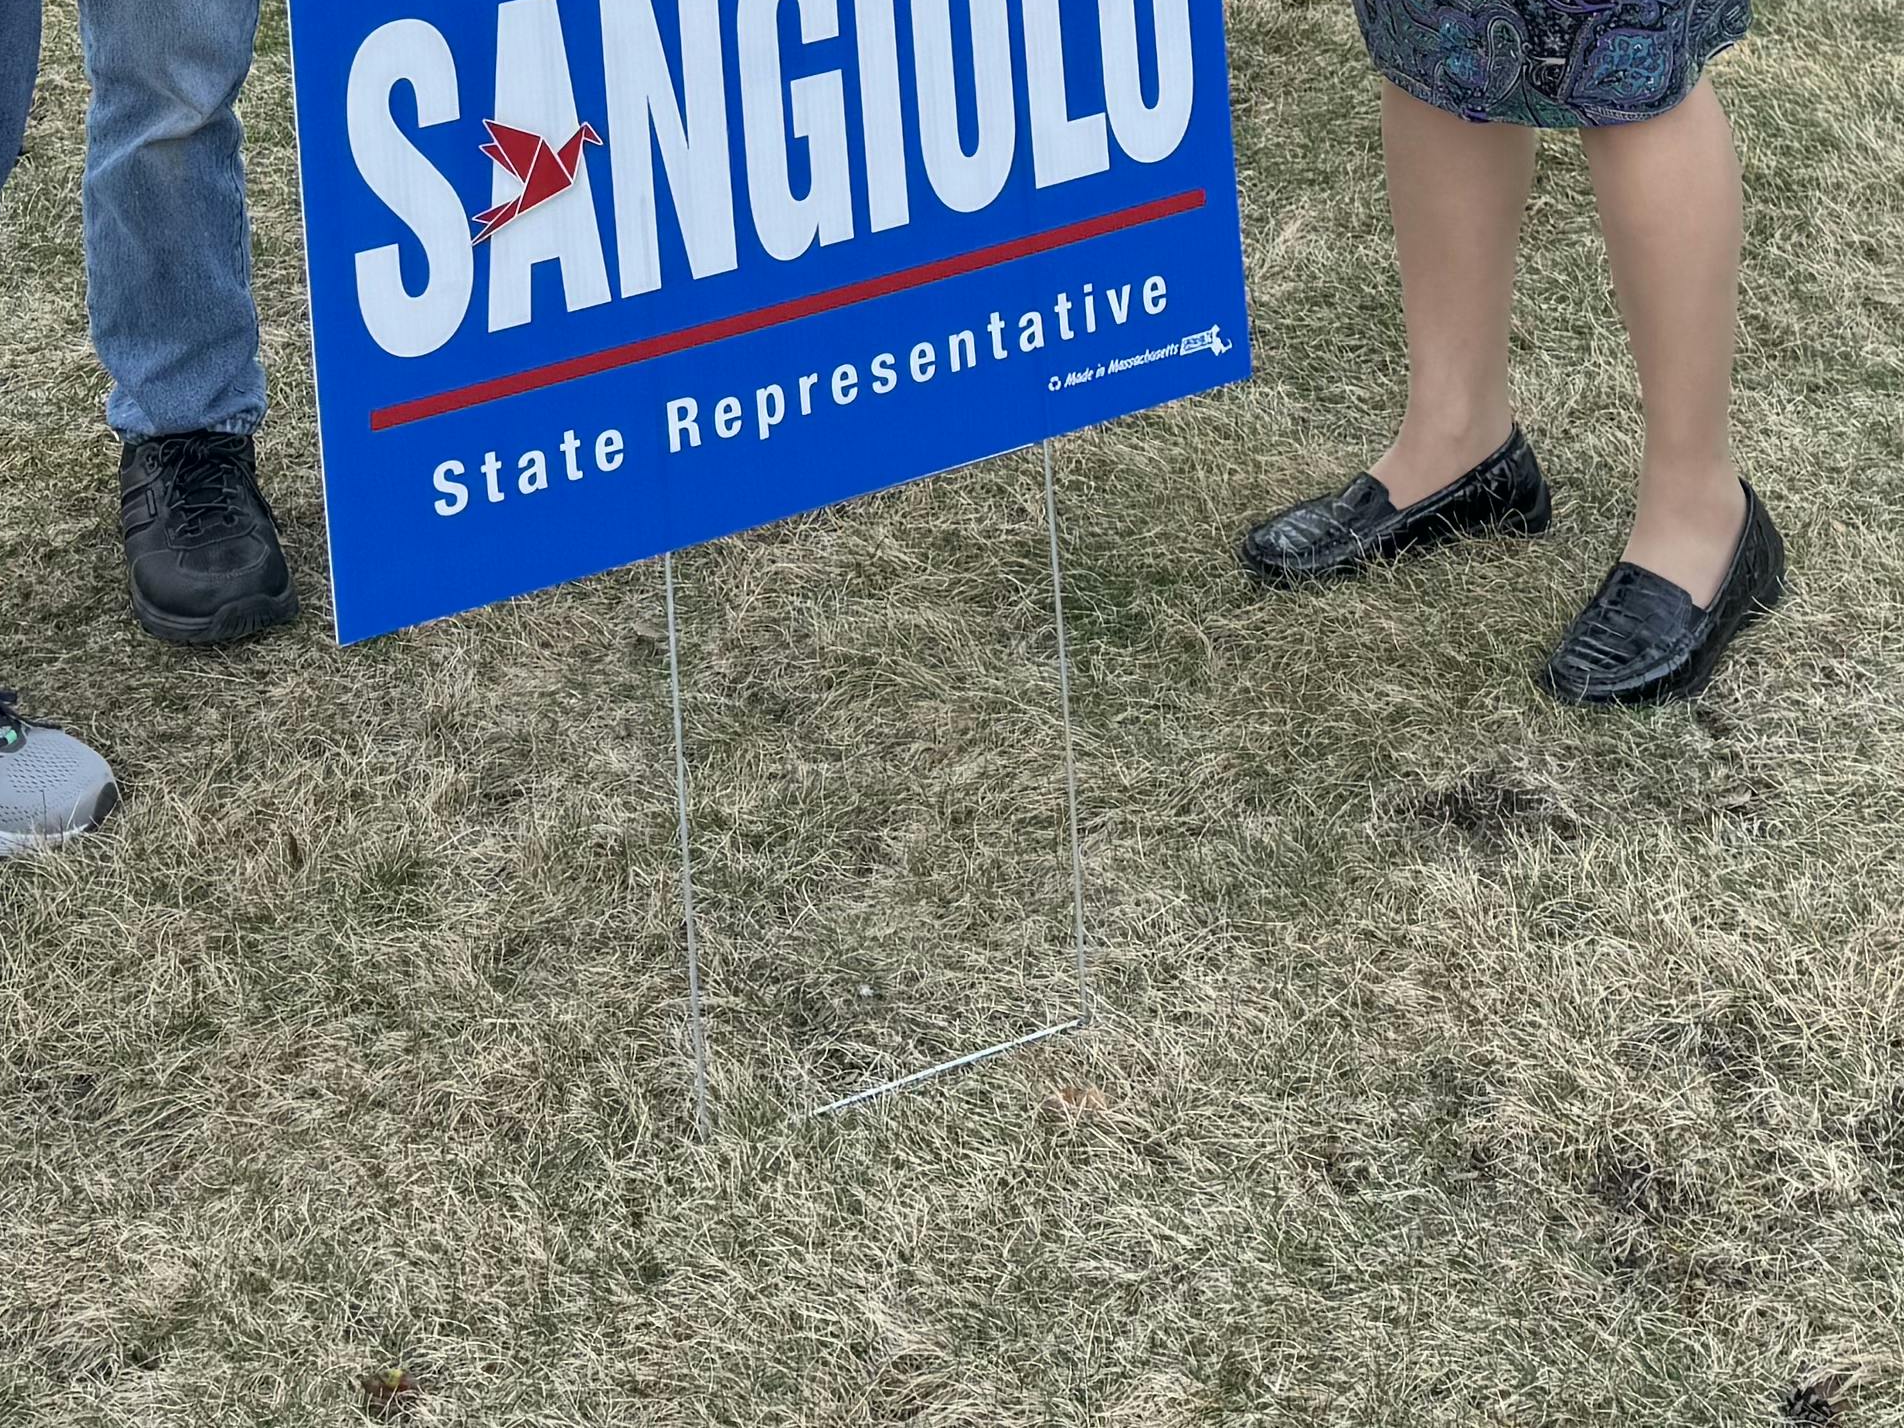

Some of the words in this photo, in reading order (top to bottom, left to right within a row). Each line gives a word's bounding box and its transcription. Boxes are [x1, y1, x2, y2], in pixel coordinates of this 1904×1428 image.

[433, 425, 624, 516] State
[667, 275, 1168, 453] Representative
[1063, 368, 1094, 388] Made
[1096, 363, 1106, 379] in
[1107, 343, 1179, 375] Massachusetts
